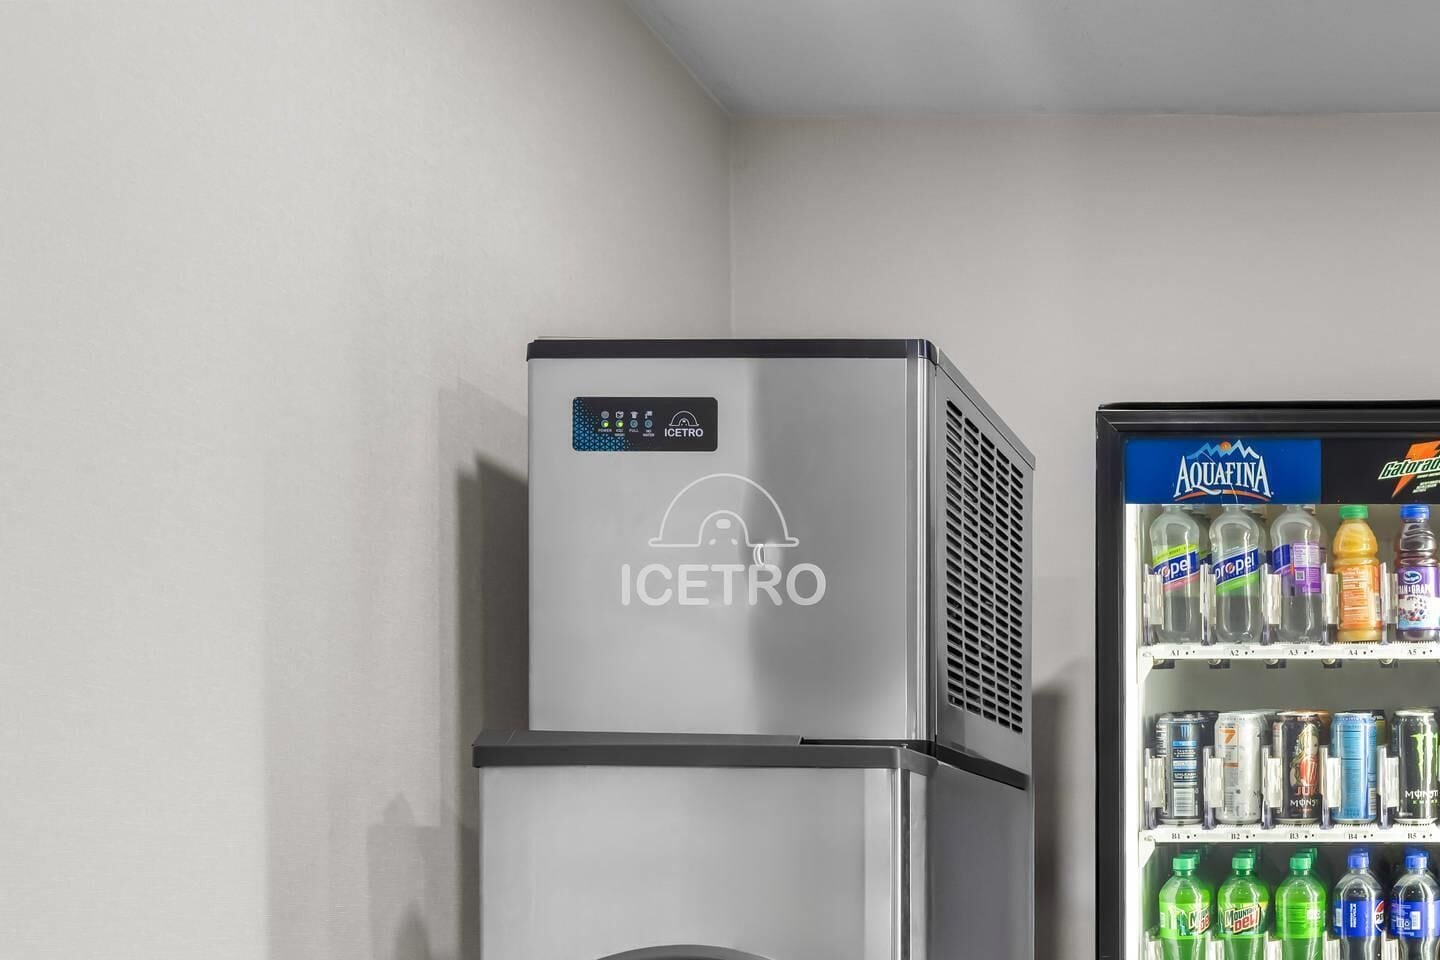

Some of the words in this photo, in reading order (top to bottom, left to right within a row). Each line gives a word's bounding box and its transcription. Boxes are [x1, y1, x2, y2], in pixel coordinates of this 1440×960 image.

[664, 428, 704, 437] ICETRO
[1173, 455, 1272, 497] AQUAFINA
[620, 563, 827, 606] ICETRO
